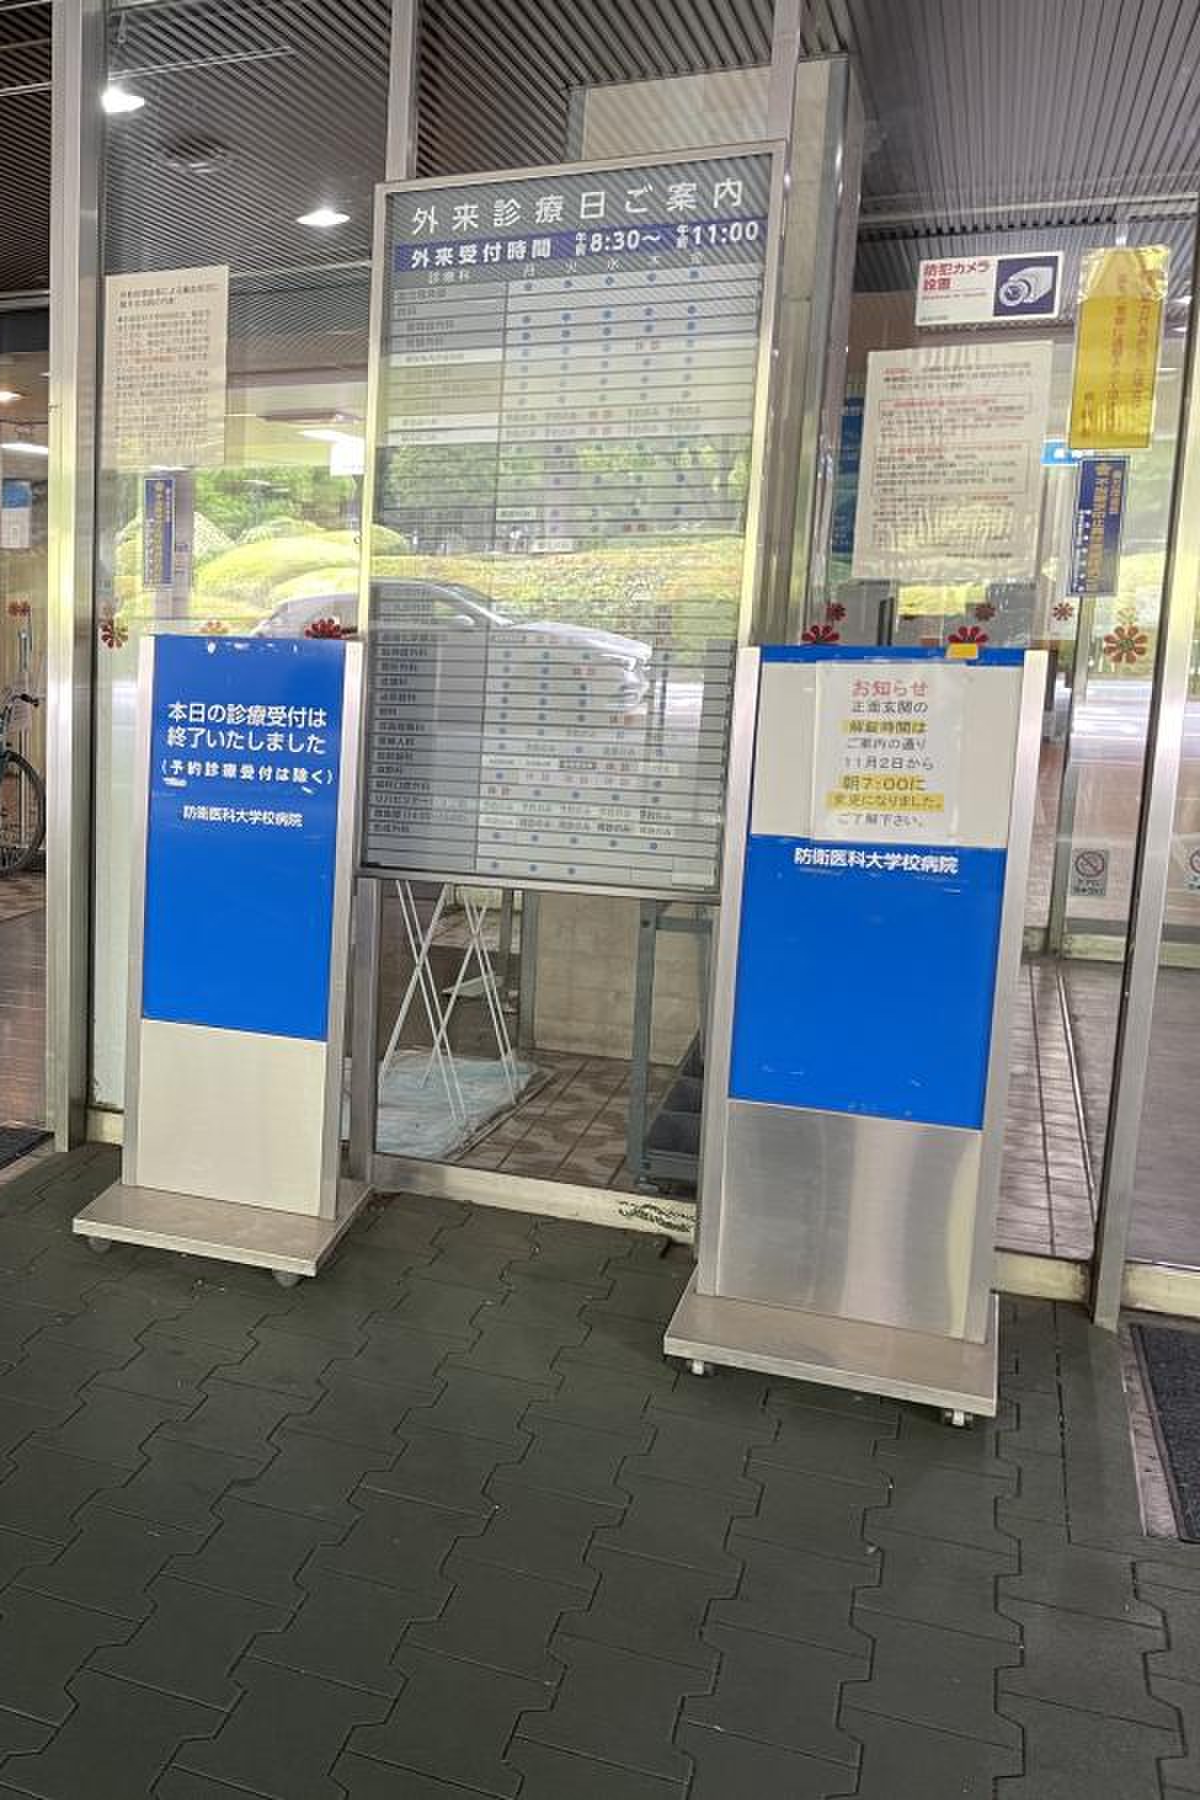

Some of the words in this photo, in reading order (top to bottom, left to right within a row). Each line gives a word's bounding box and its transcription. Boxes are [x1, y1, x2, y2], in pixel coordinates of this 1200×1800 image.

[411, 178, 744, 235] 外来診療日ご案内
[411, 238, 551, 268] 外来受付時間
[924, 260, 990, 277] 防犯カメラ
[852, 680, 928, 697] お知らせ
[167, 701, 327, 729] 本日の診療受付は
[851, 700, 928, 714] 正面玄関の
[166, 726, 326, 755] 終了いたしました
[844, 755, 934, 770] 11月2日から
[843, 775, 927, 792] 朝7:00に
[182, 805, 304, 828] 防衛医科大学校病院
[794, 847, 958, 874] 防衛医科大学校病院
